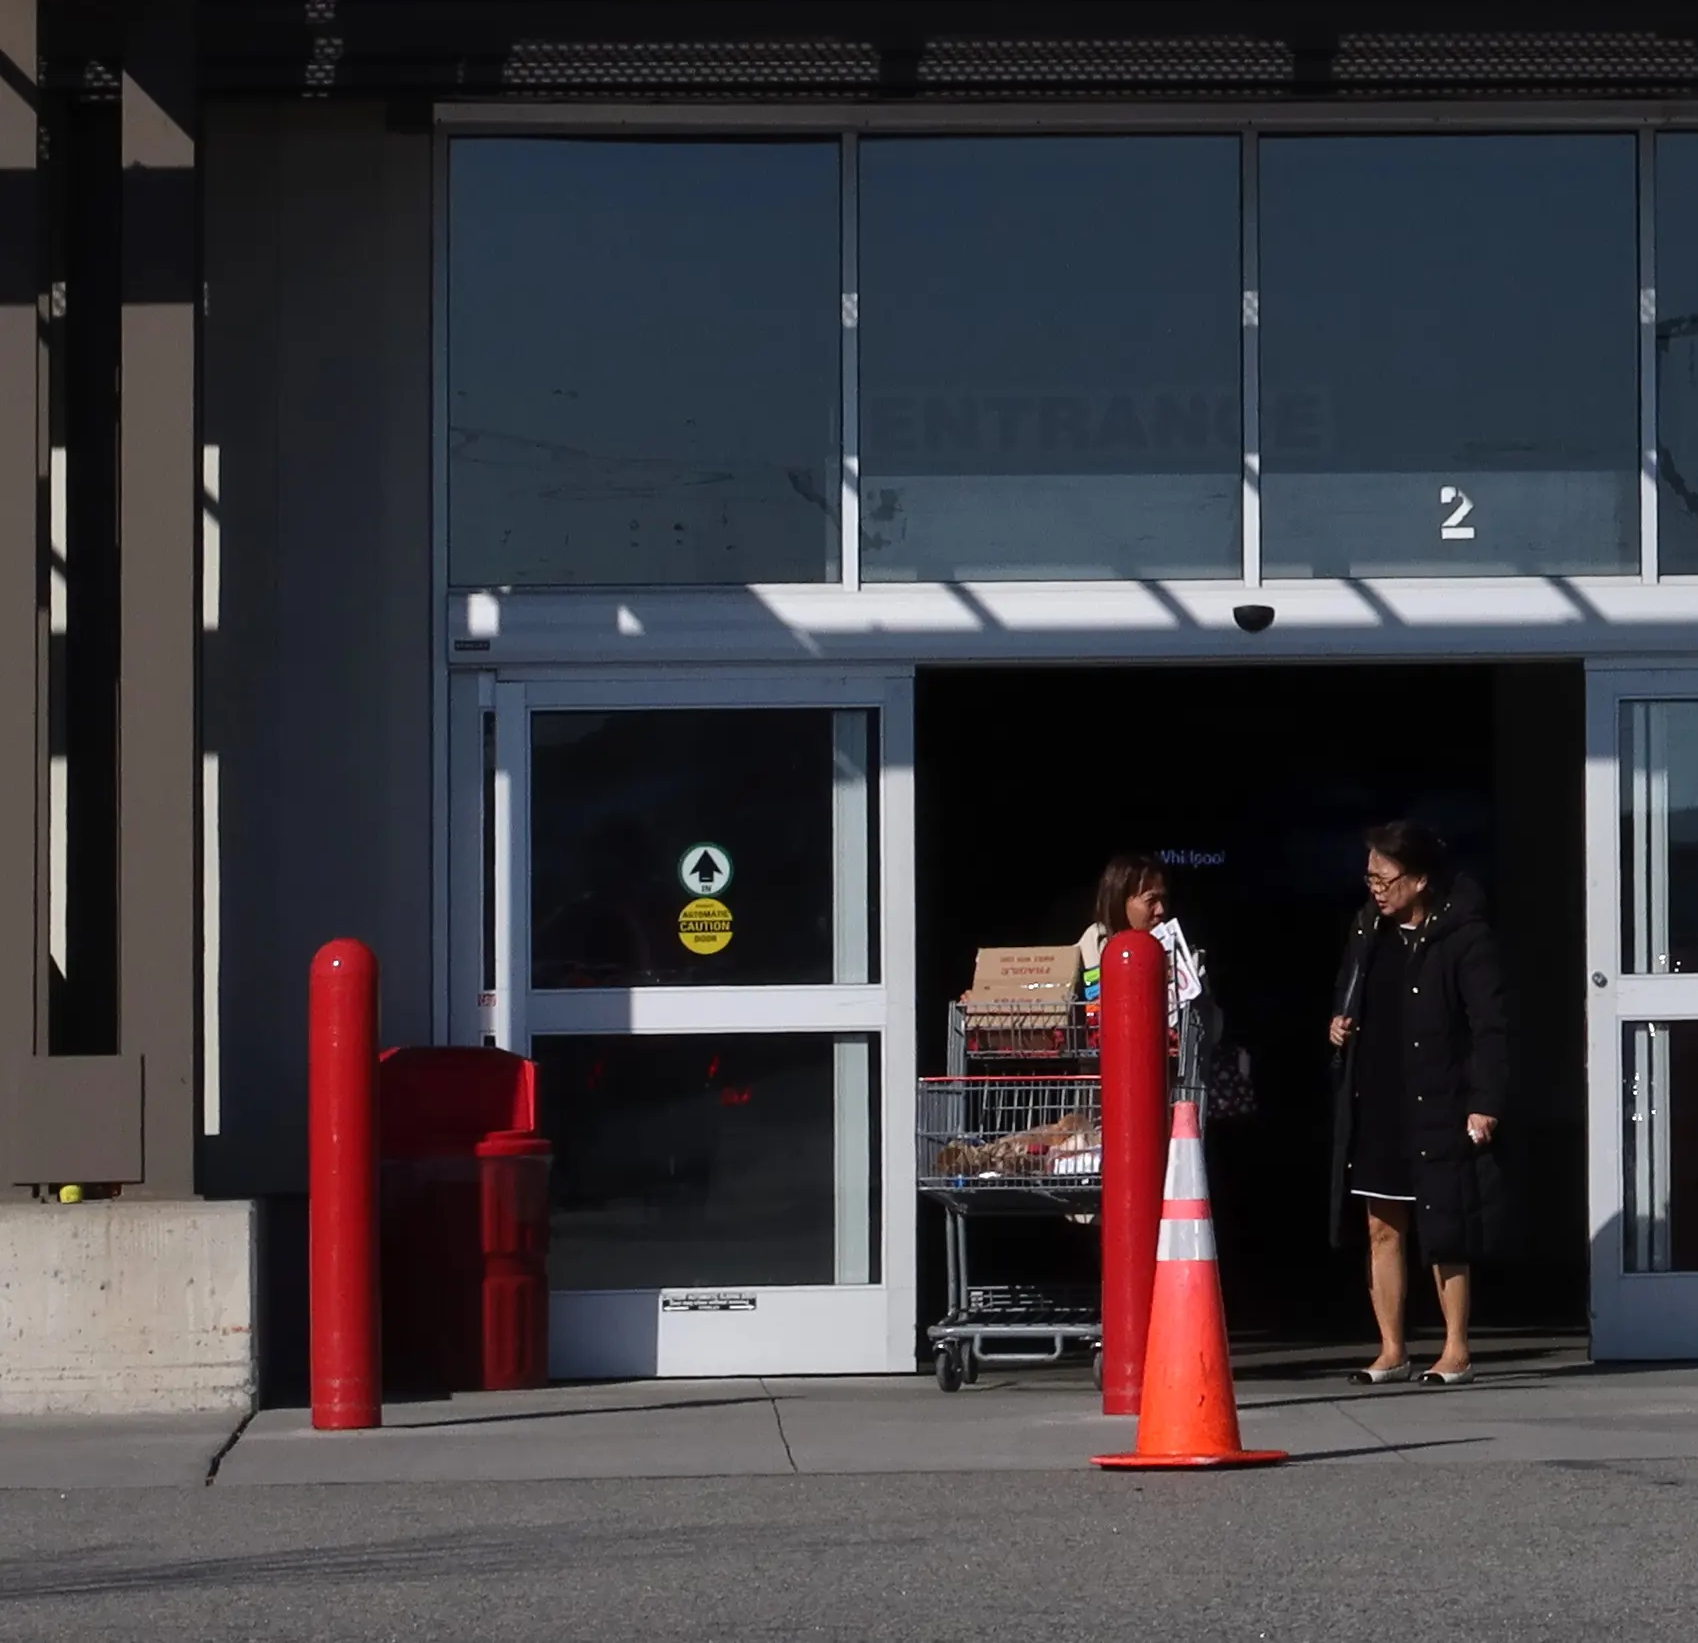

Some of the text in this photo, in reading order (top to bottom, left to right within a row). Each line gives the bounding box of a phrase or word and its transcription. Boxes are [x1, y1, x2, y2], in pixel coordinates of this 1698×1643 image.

[1441, 486, 1474, 539] 2
[1153, 849, 1227, 868] Whilpool
[701, 885, 712, 893] IN
[679, 921, 730, 931] CAUTION
